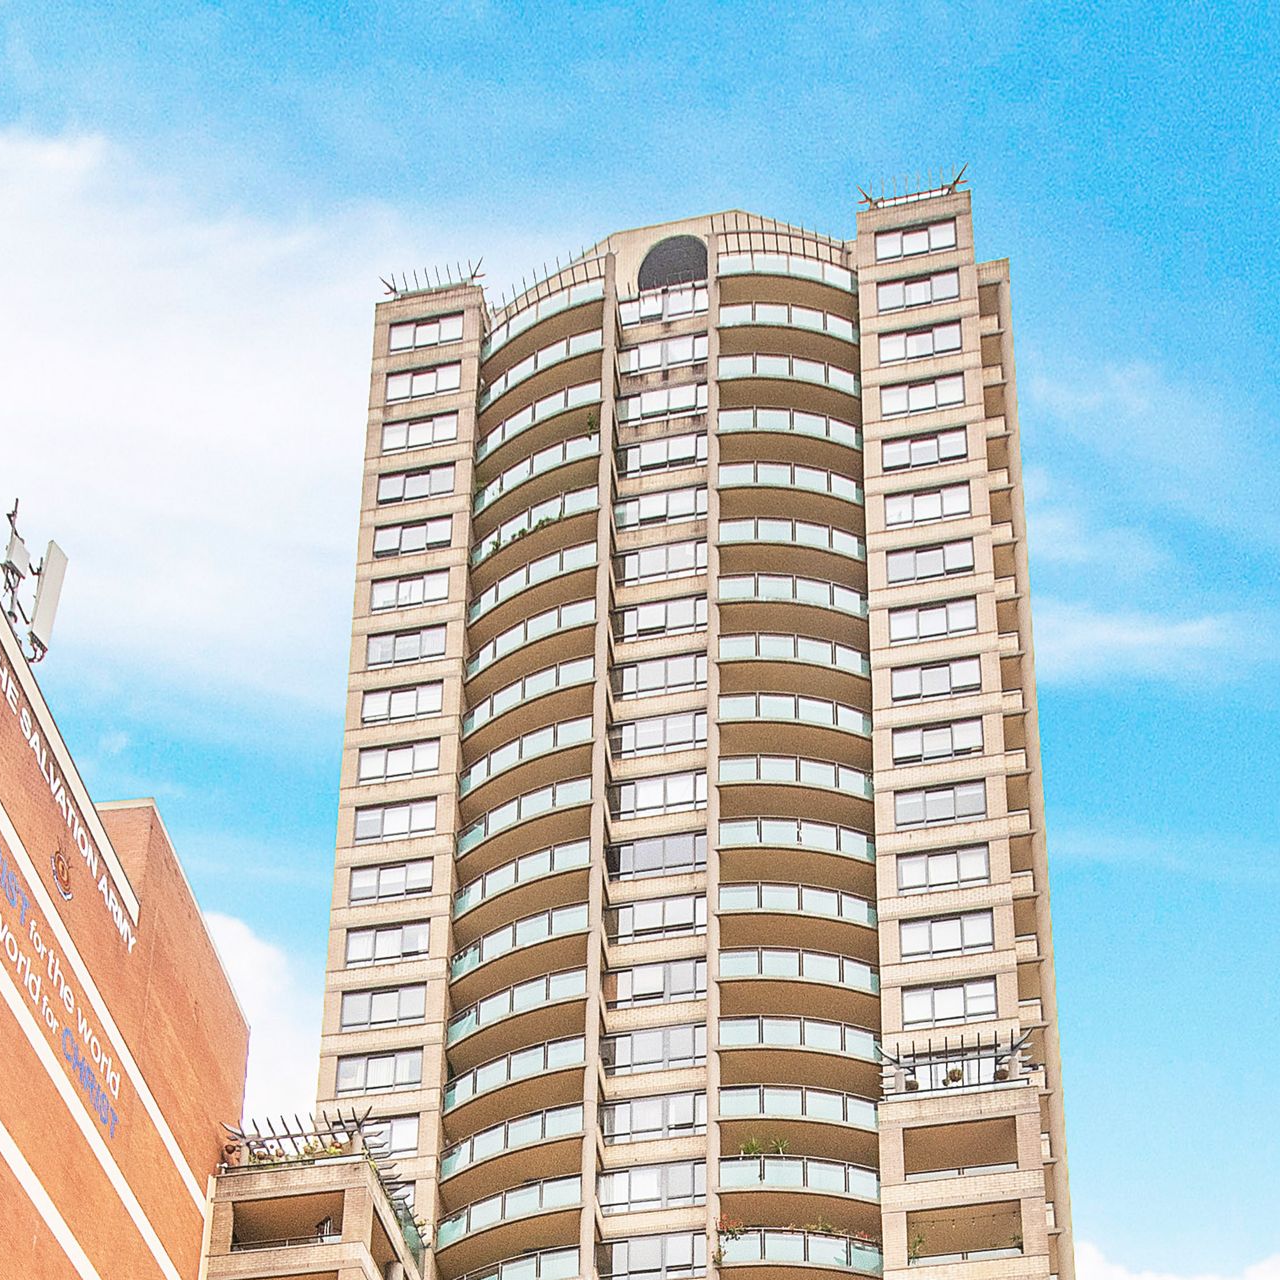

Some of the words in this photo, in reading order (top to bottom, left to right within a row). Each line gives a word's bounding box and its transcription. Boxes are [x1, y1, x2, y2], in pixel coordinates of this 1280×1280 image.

[20, 706, 99, 879] SALVATION
[97, 874, 136, 954] ARMY
[28, 919, 47, 960] for
[46, 948, 75, 1014] the
[77, 1007, 121, 1100] world
[41, 995, 60, 1035] for
[61, 1027, 120, 1140] CHRIST
